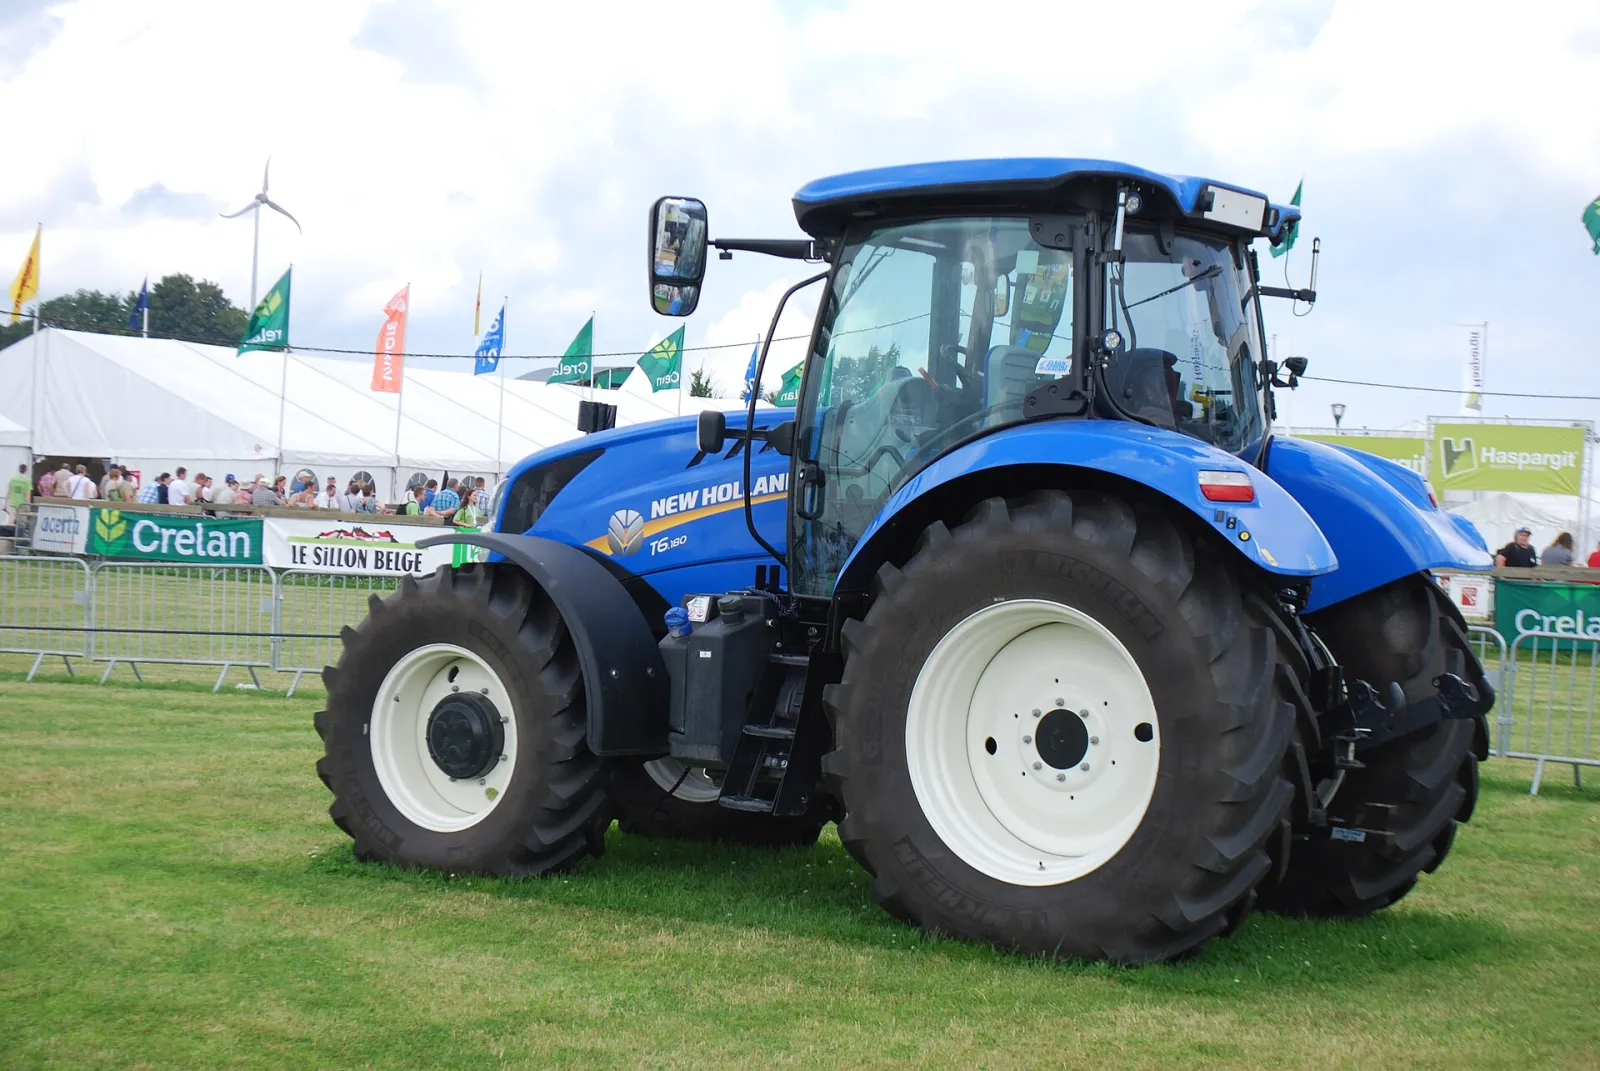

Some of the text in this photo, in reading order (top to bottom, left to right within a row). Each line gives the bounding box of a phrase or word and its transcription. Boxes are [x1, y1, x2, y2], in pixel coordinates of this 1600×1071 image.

[1480, 446, 1576, 471] Haspargit
[651, 472, 789, 519] NEW HOLAN
[132, 519, 250, 558] Crelan
[649, 535, 687, 556] T6.180
[292, 545, 307, 564] LE
[374, 550, 422, 572] BELGE
[1514, 608, 1600, 639] Crela
